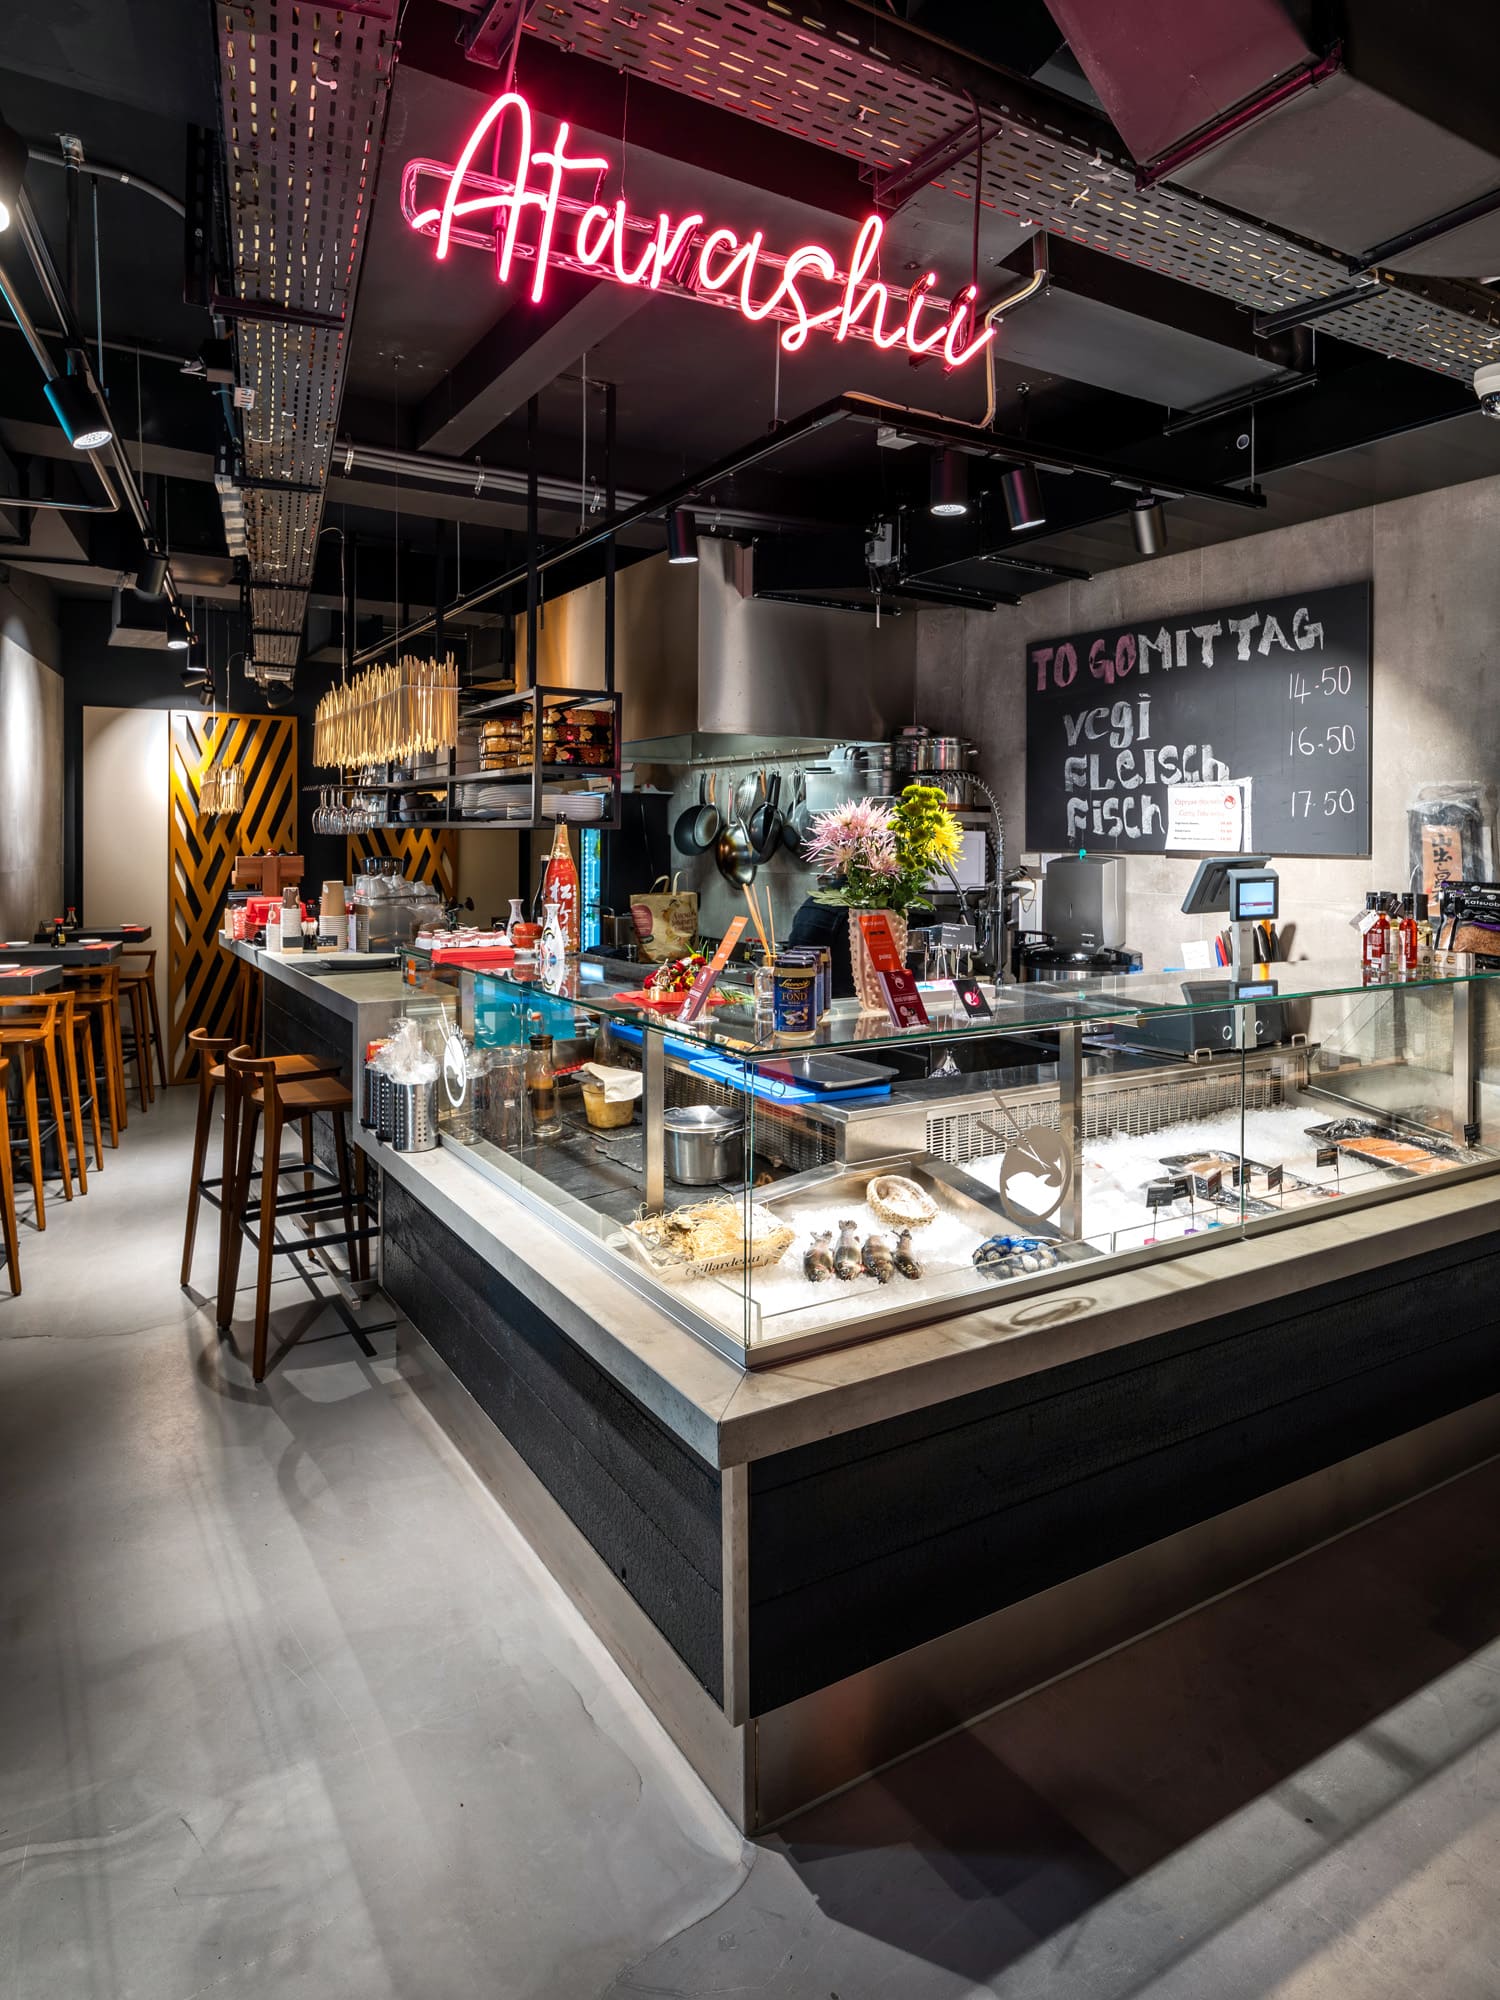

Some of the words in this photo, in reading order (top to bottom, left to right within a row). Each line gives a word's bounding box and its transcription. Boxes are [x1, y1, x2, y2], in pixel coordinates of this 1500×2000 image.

[1032, 643, 1078, 691] TO
[1088, 633, 1137, 685] GO
[1138, 607, 1325, 675] MITTAG
[782, 991, 809, 1001] FOND
